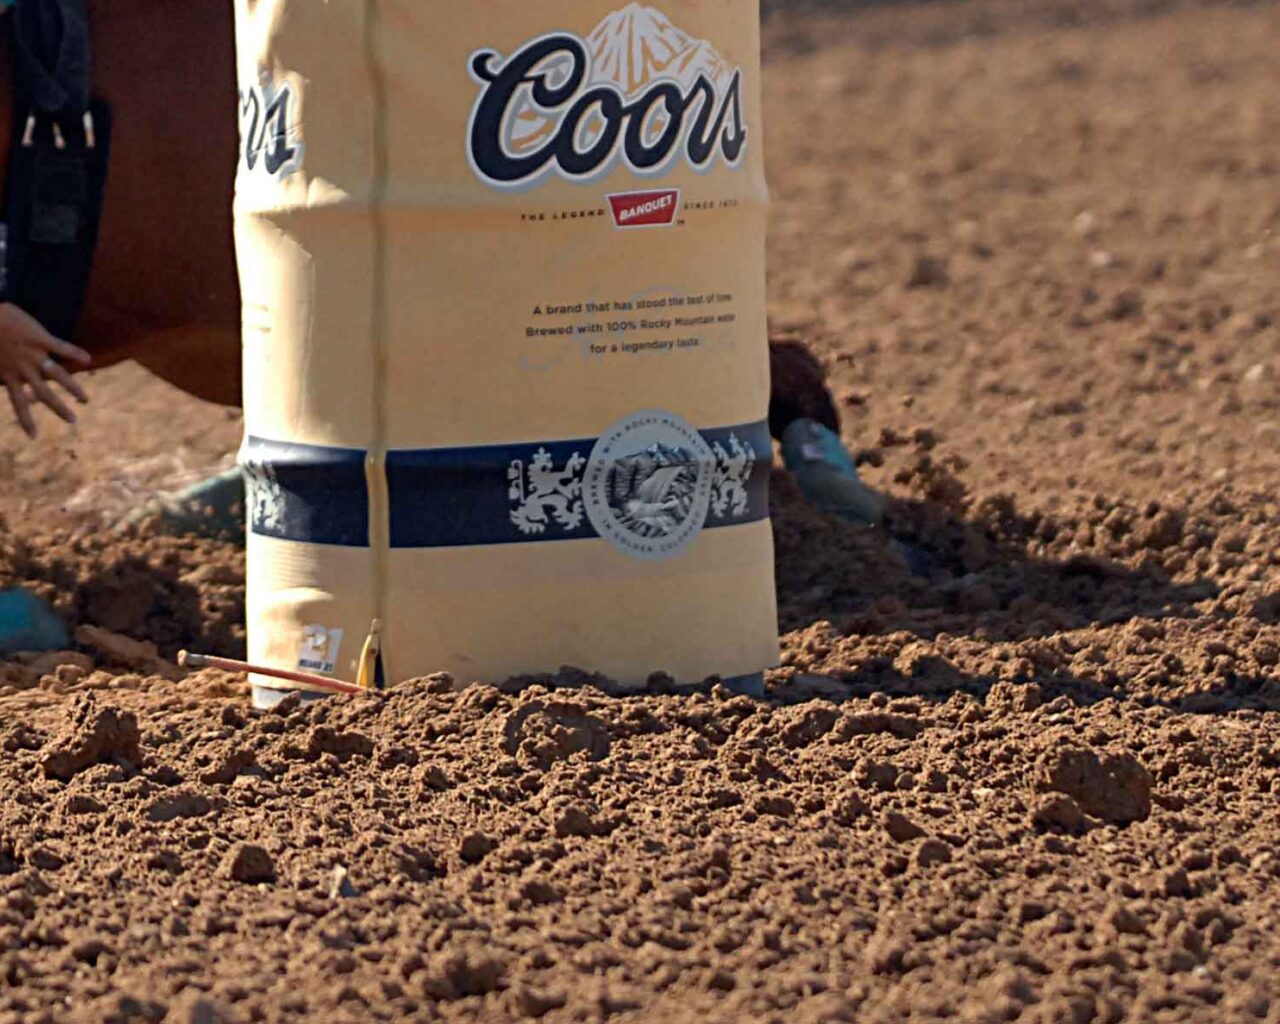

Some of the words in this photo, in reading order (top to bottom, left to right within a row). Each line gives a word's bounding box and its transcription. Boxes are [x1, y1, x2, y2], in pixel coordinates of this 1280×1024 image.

[470, 33, 747, 183] Coors
[552, 208, 605, 220] LEGEND
[619, 194, 673, 221] BANQUET
[533, 305, 542, 315] A
[546, 303, 582, 315] brand
[586, 301, 610, 312] that
[614, 300, 633, 311] has
[636, 297, 667, 309] stood
[668, 296, 684, 306] the
[526, 324, 574, 336] Brewed
[577, 322, 603, 333] with
[607, 320, 637, 332] 100%
[640, 318, 672, 329] Rocky
[674, 315, 715, 326] Mountain
[590, 342, 607, 353] for
[610, 343, 618, 352] a
[621, 339, 674, 353] legendary
